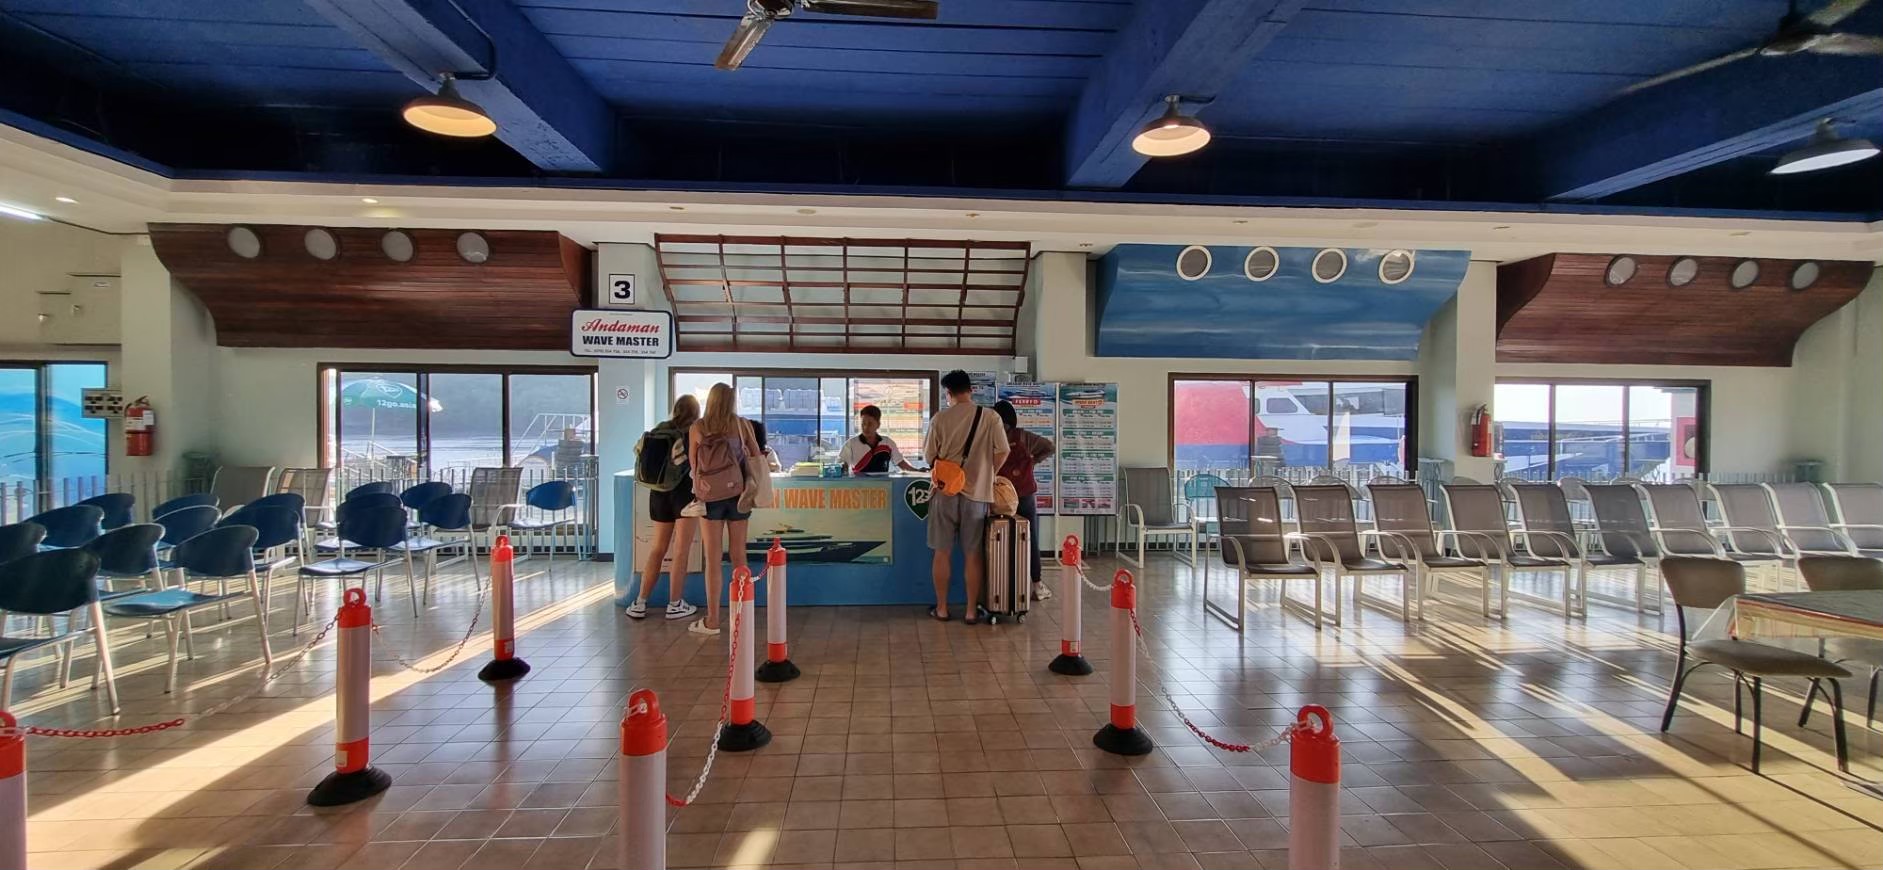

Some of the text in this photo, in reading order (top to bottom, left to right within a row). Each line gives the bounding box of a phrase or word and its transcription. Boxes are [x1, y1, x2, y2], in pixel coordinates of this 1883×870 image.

[614, 280, 631, 299] 3
[581, 318, 660, 334] Andaman
[582, 335, 659, 347] WAVE MASTER
[784, 488, 825, 509] WAVE
[829, 488, 887, 510] MASTER
